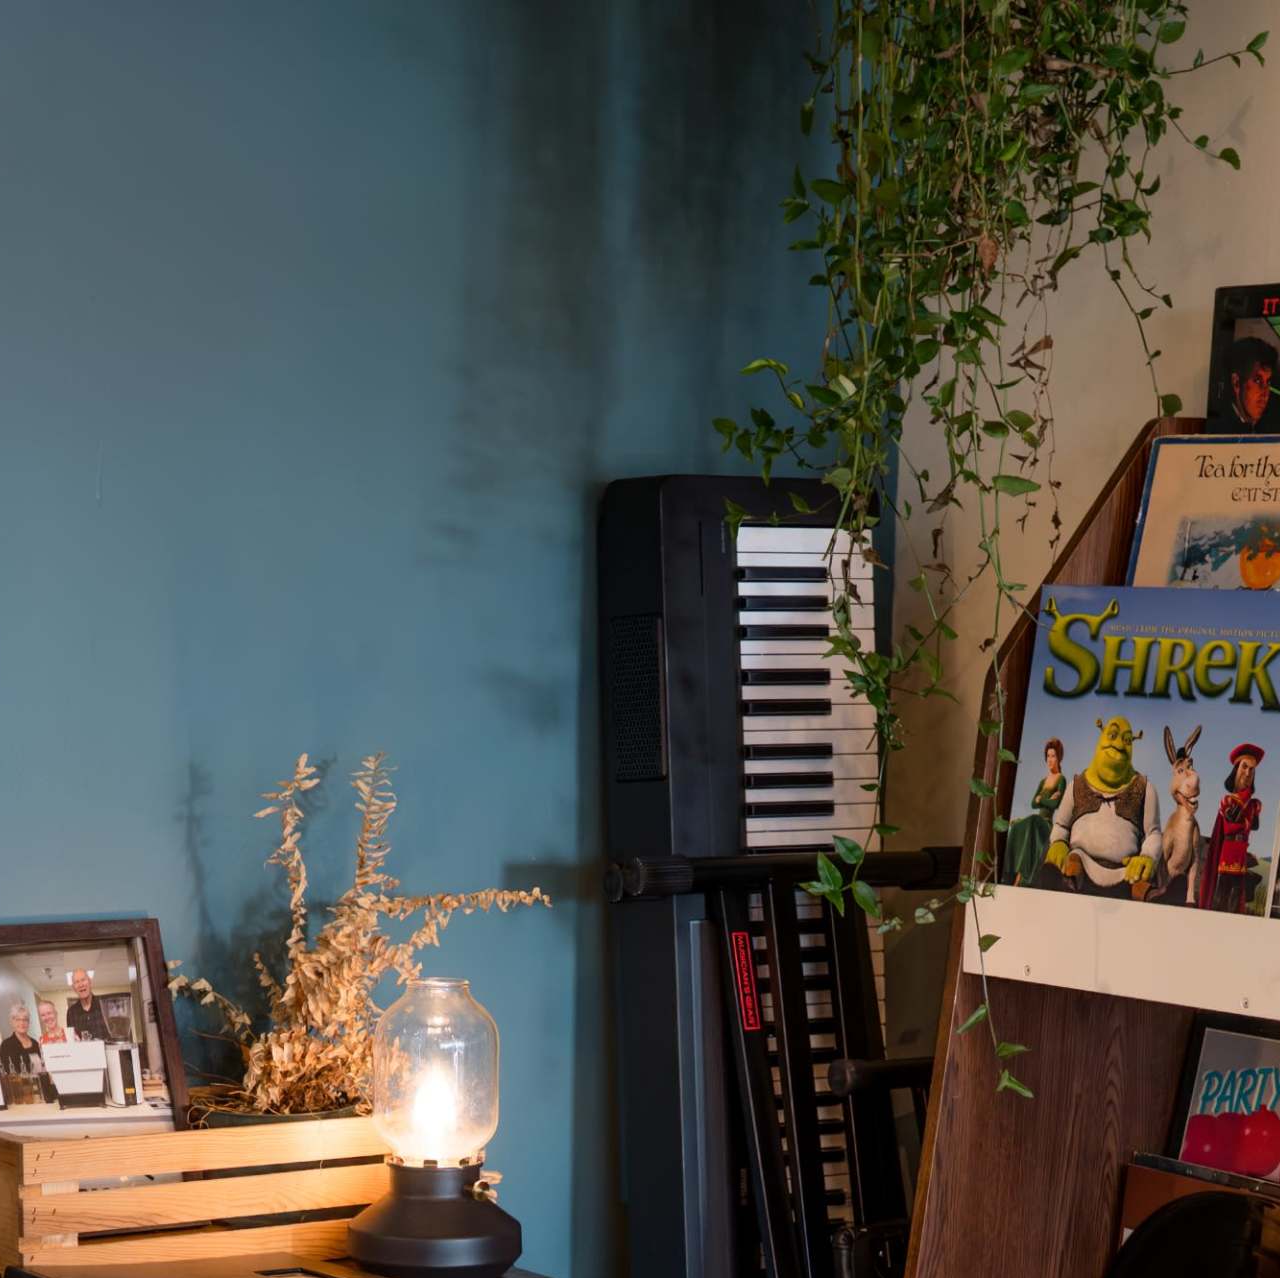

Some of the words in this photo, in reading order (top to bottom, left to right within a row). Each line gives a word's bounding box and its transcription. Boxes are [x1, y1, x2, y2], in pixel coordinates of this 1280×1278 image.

[1194, 454, 1226, 478] Tea
[1229, 455, 1254, 478] for
[1231, 487, 1262, 502] CAT
